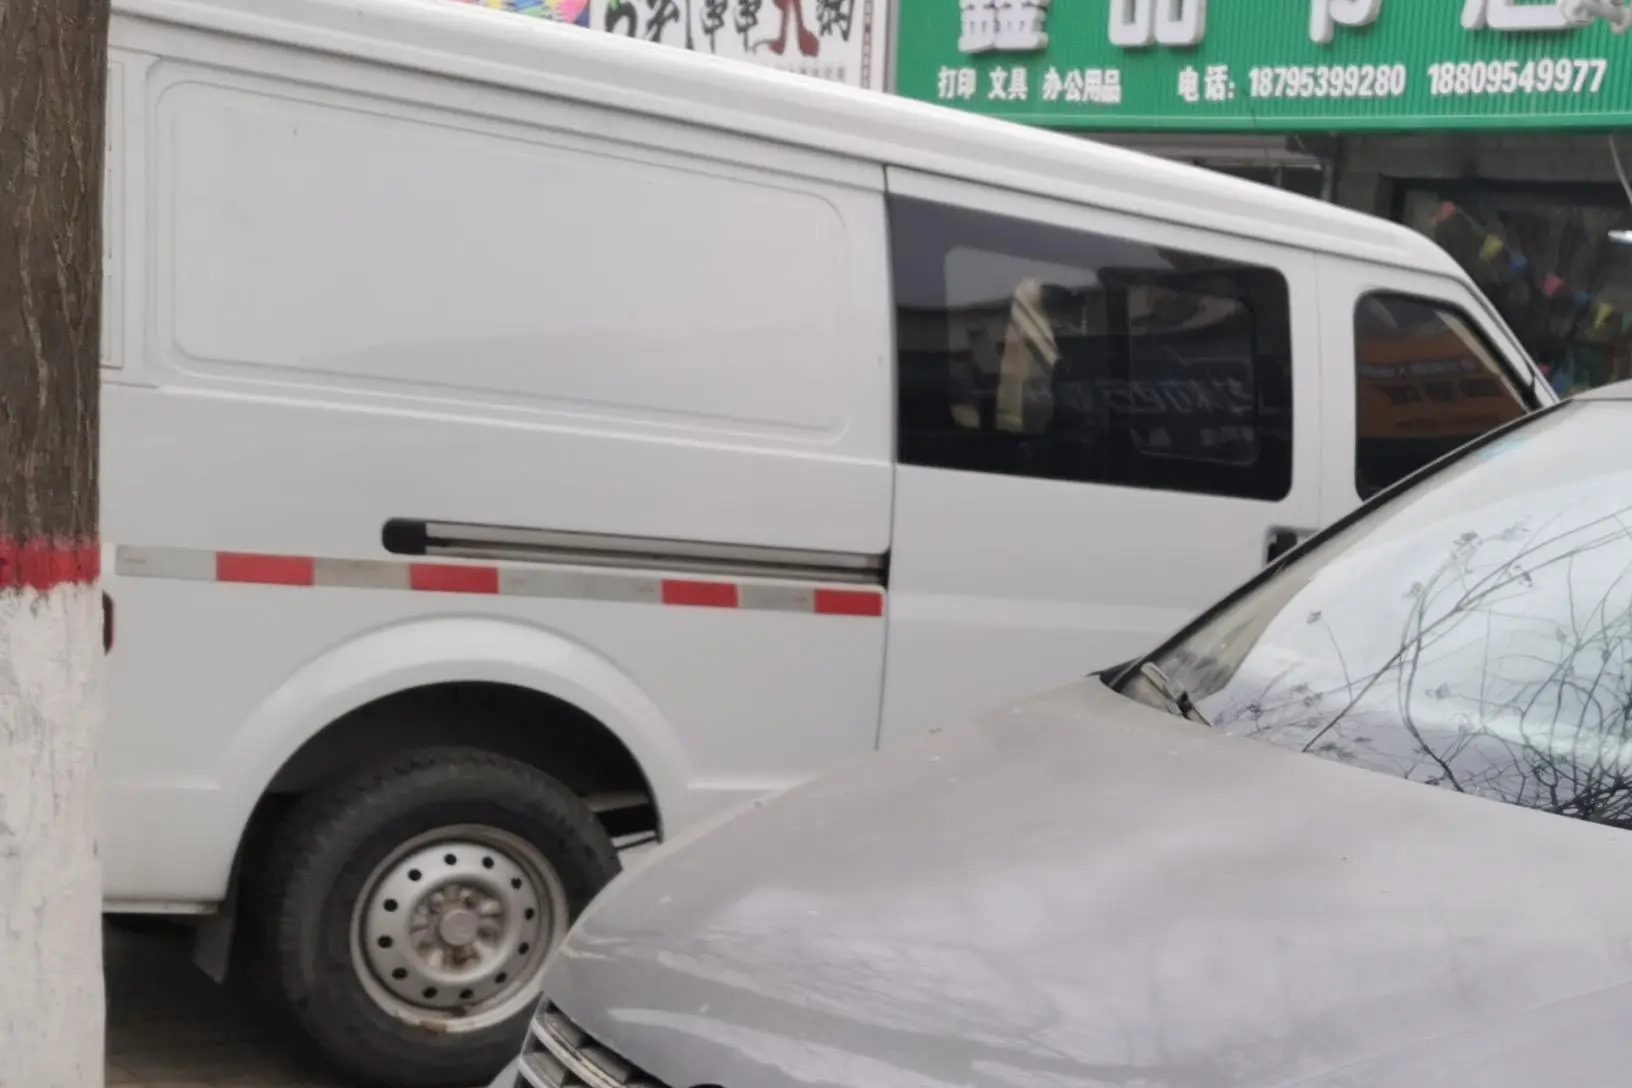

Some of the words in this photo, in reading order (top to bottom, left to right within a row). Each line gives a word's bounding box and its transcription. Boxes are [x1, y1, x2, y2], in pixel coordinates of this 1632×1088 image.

[938, 65, 977, 100] 打印
[988, 66, 1028, 100] 文具
[1042, 67, 1121, 103] 办公用品
[1248, 63, 1406, 99] 18795399280
[1427, 59, 1607, 97] 18809549977
